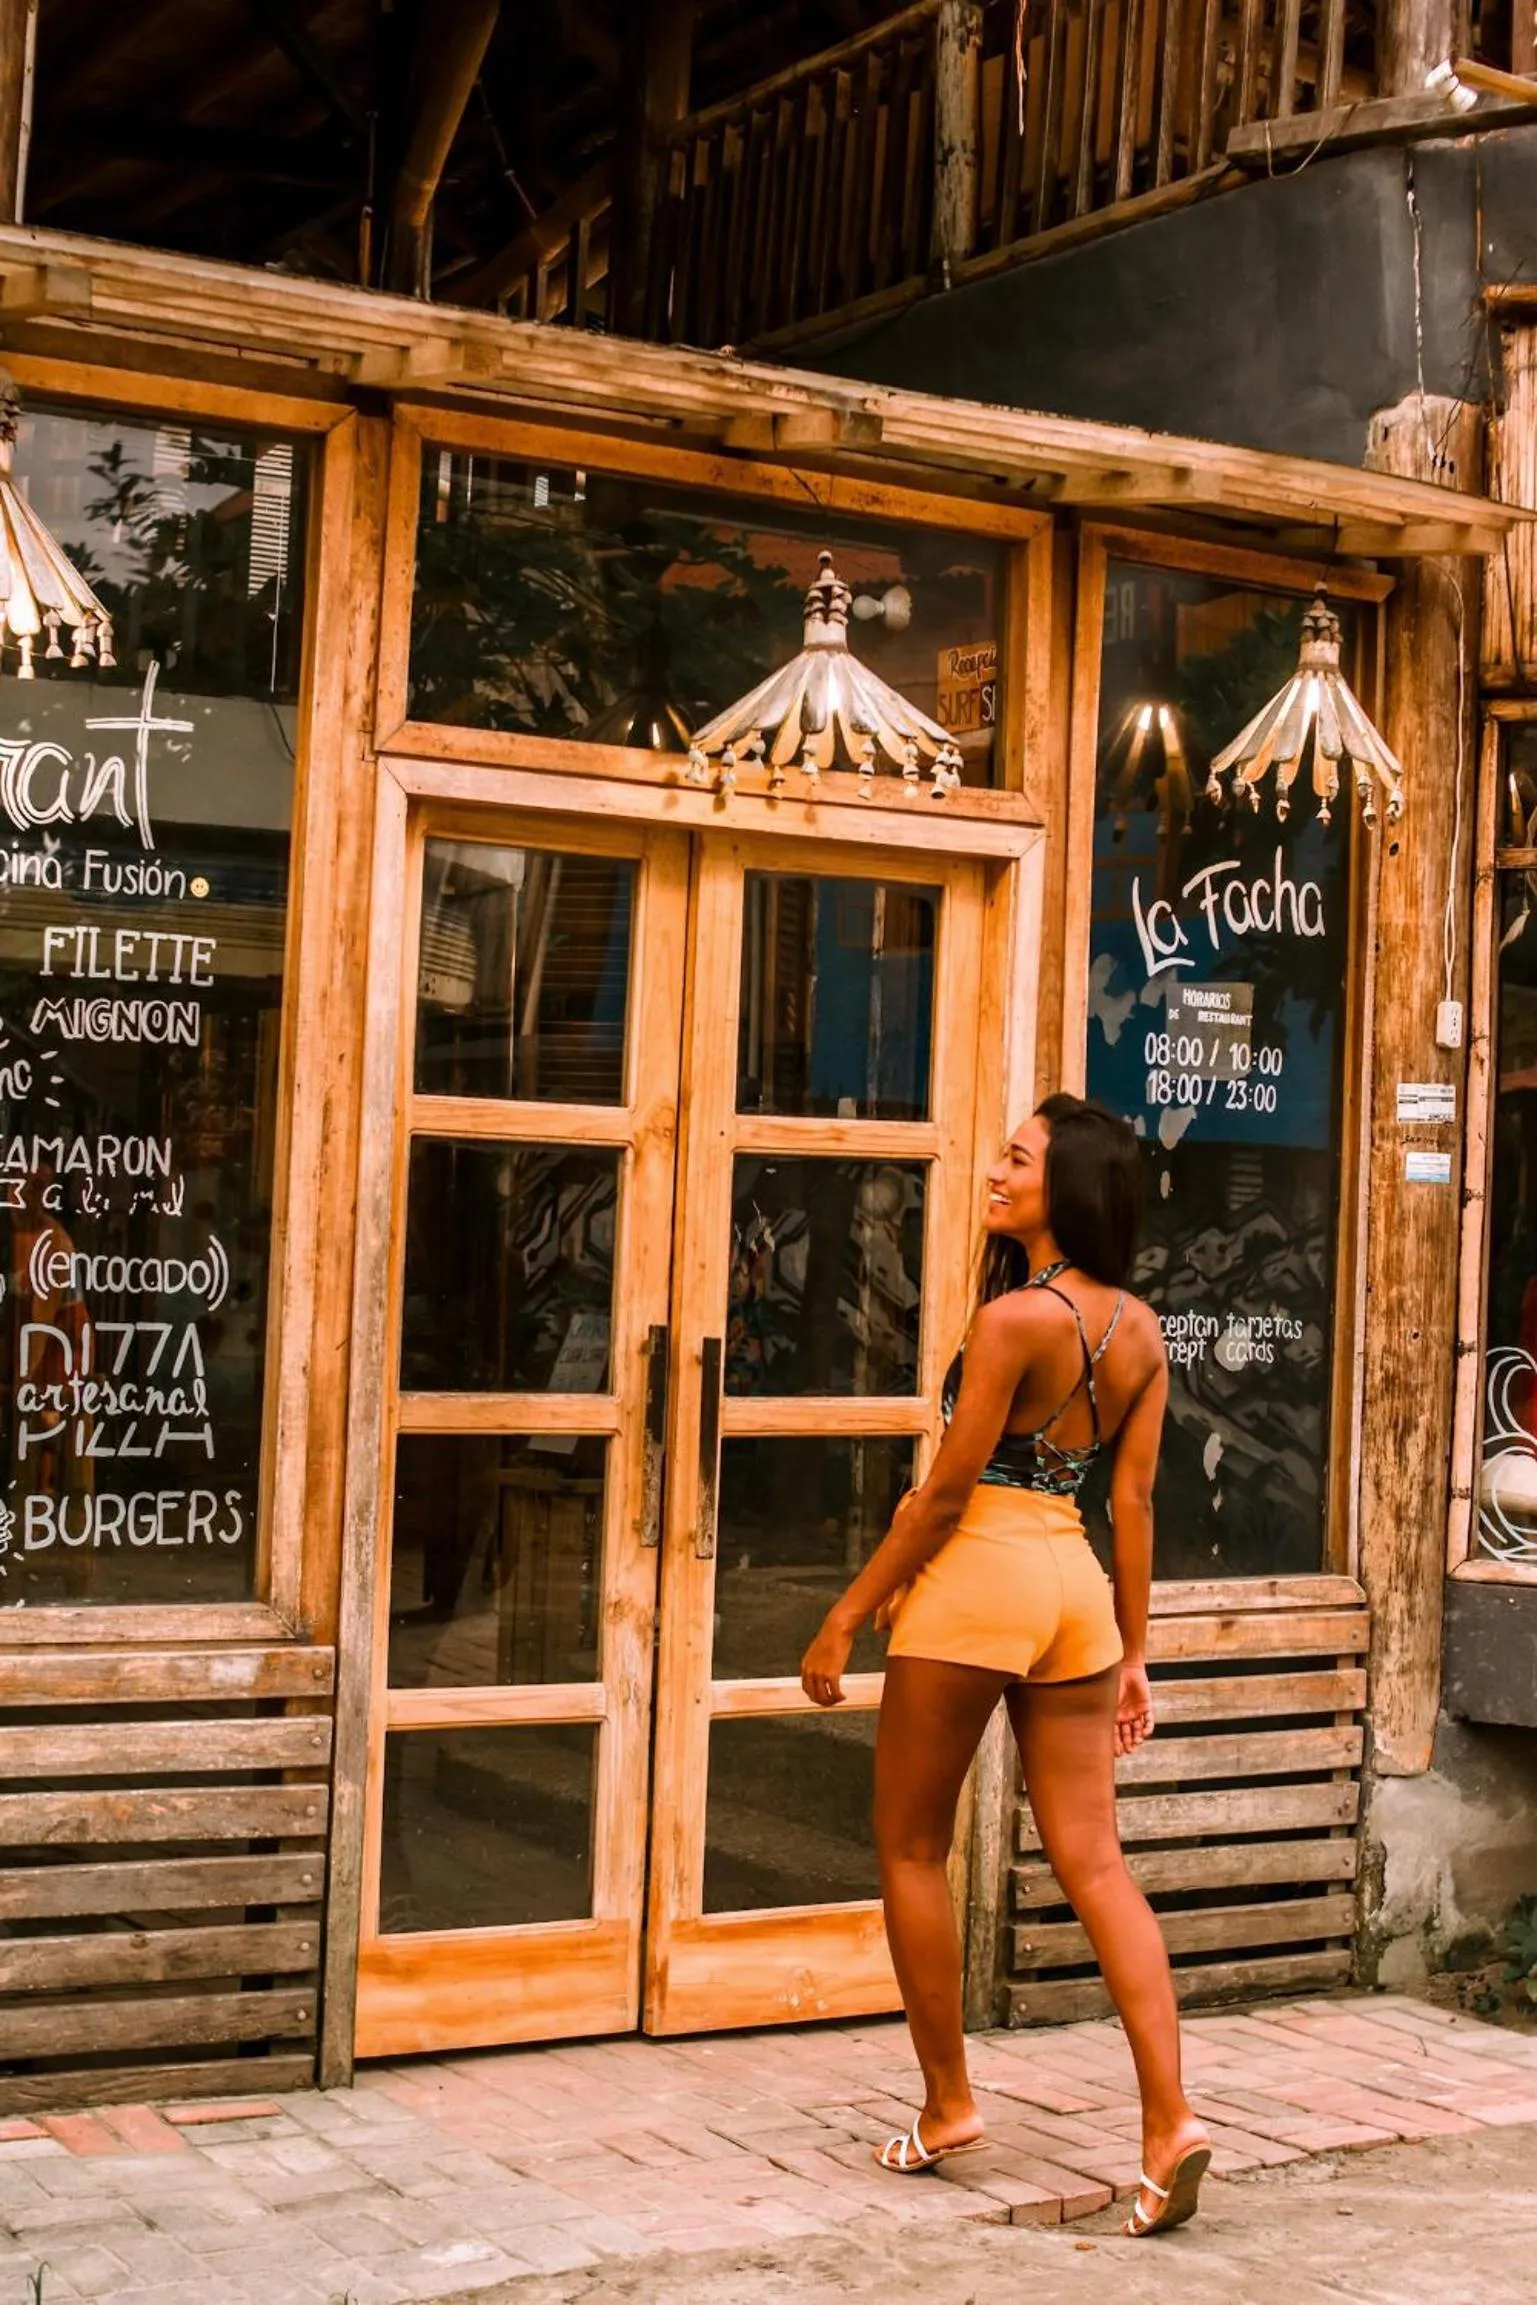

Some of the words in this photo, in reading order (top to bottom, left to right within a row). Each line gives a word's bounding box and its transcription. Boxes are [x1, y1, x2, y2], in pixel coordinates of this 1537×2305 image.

[938, 687, 980, 728] SURF
[83, 849, 187, 899] Fusión
[1132, 876, 1195, 977] La
[1182, 845, 1325, 950] Facha
[39, 926, 217, 987] FILETTE
[30, 997, 200, 1047] MIGNON
[1183, 988, 1231, 1010] HORARIOS
[1144, 1032, 1203, 1067] 08:00
[1229, 1043, 1283, 1076] 10:00
[1145, 1069, 1203, 1105] 18:00
[1225, 1080, 1277, 1113] 23:00
[0, 1135, 172, 1178] AMARON
[16, 1371, 210, 1417] artesanal
[24, 1490, 243, 1550] BURGERS
